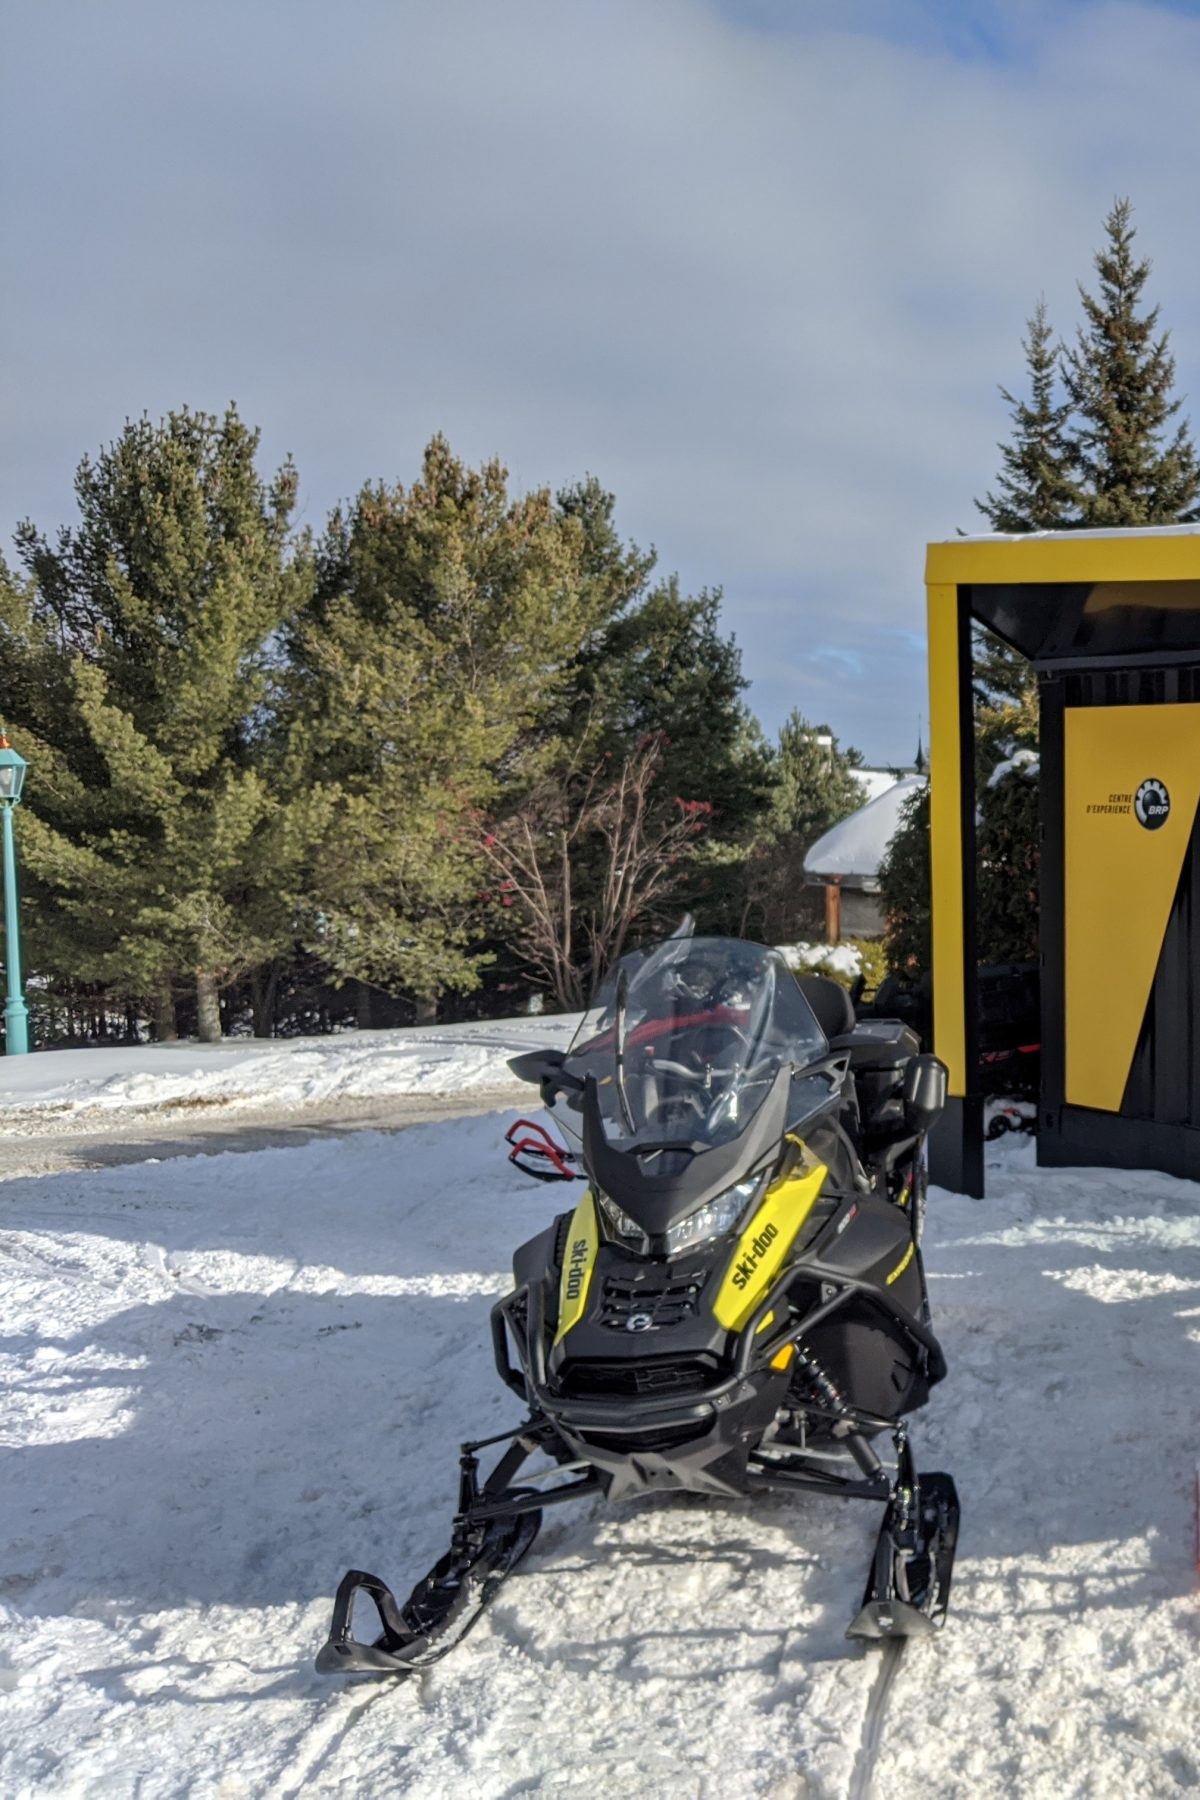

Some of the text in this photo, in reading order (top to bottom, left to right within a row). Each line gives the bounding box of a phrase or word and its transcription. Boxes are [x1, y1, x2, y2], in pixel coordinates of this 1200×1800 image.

[1108, 793, 1132, 803] CENTRE
[1148, 805, 1169, 815] BRP
[567, 1239, 589, 1300] ski-doo
[731, 1222, 779, 1291] ski-doo
